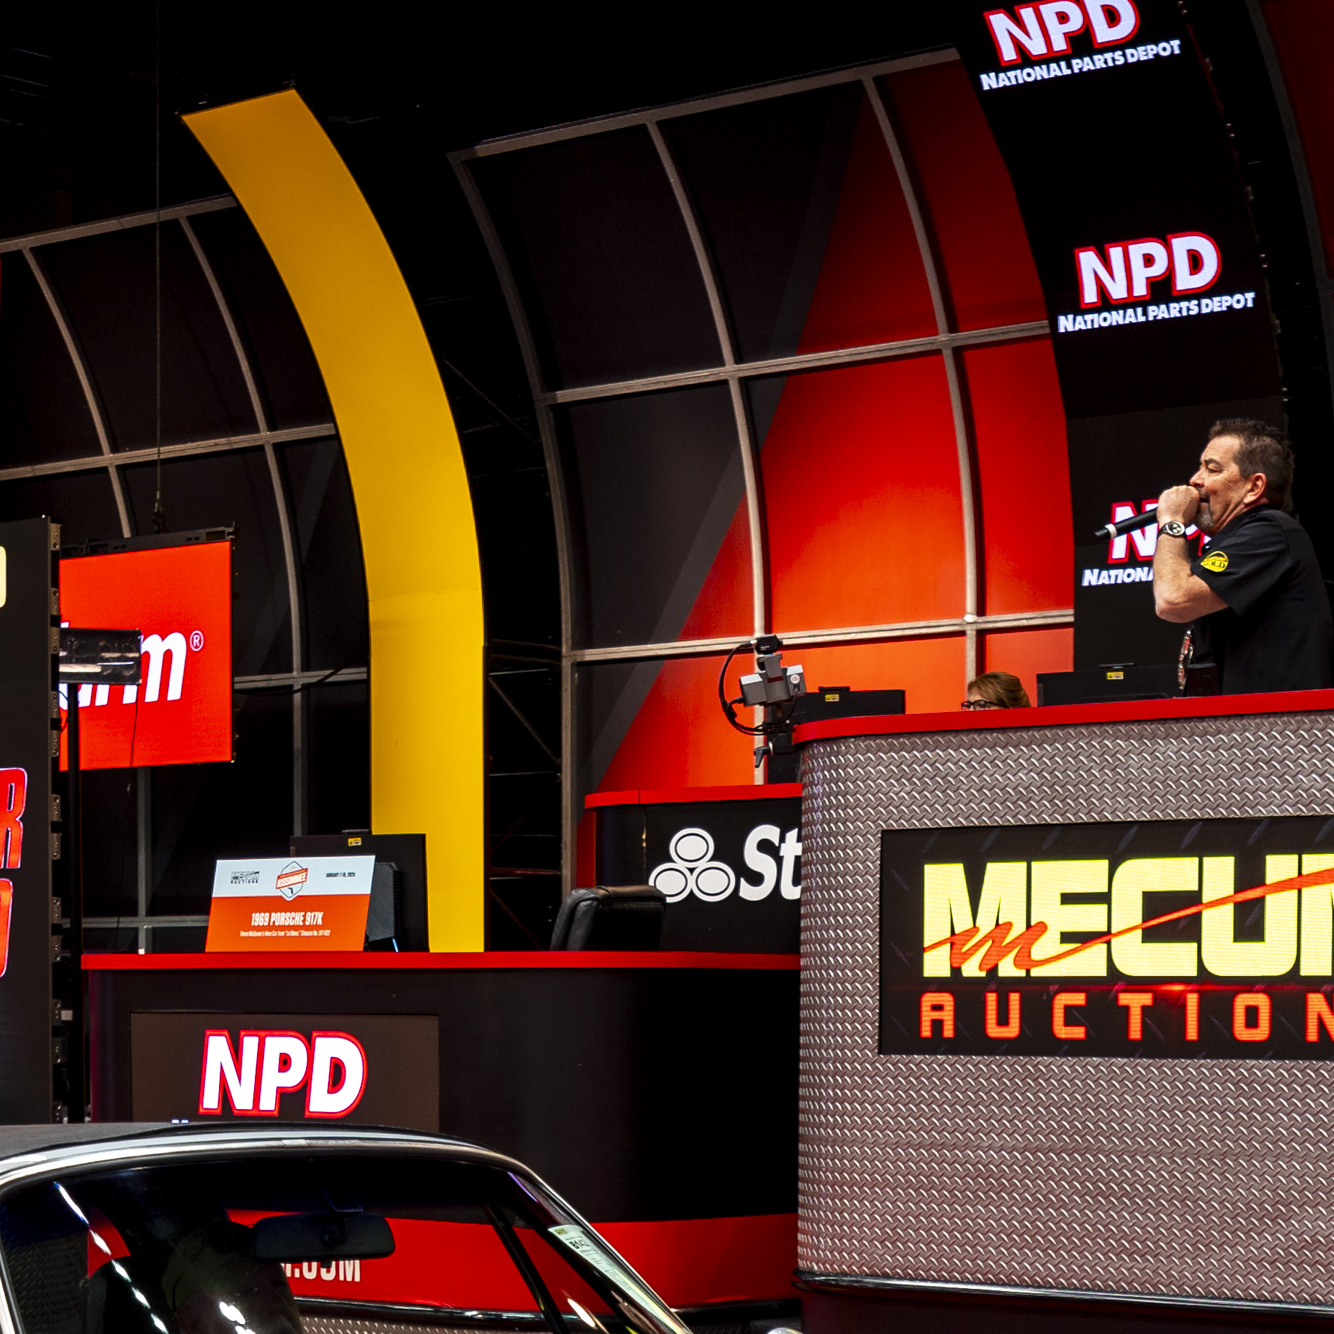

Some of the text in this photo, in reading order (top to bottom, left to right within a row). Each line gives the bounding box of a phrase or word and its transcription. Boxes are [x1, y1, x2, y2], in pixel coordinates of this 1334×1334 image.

[984, 0, 1139, 66] NPD
[980, 39, 1181, 91] NATIONAL PARTS DEPOT
[1073, 231, 1222, 309] NPD
[1058, 292, 1255, 333] NATIONAL PARTS DEPOT
[251, 911, 324, 927] 1969 PORSCHE 917K
[199, 1029, 368, 1119] NPD
